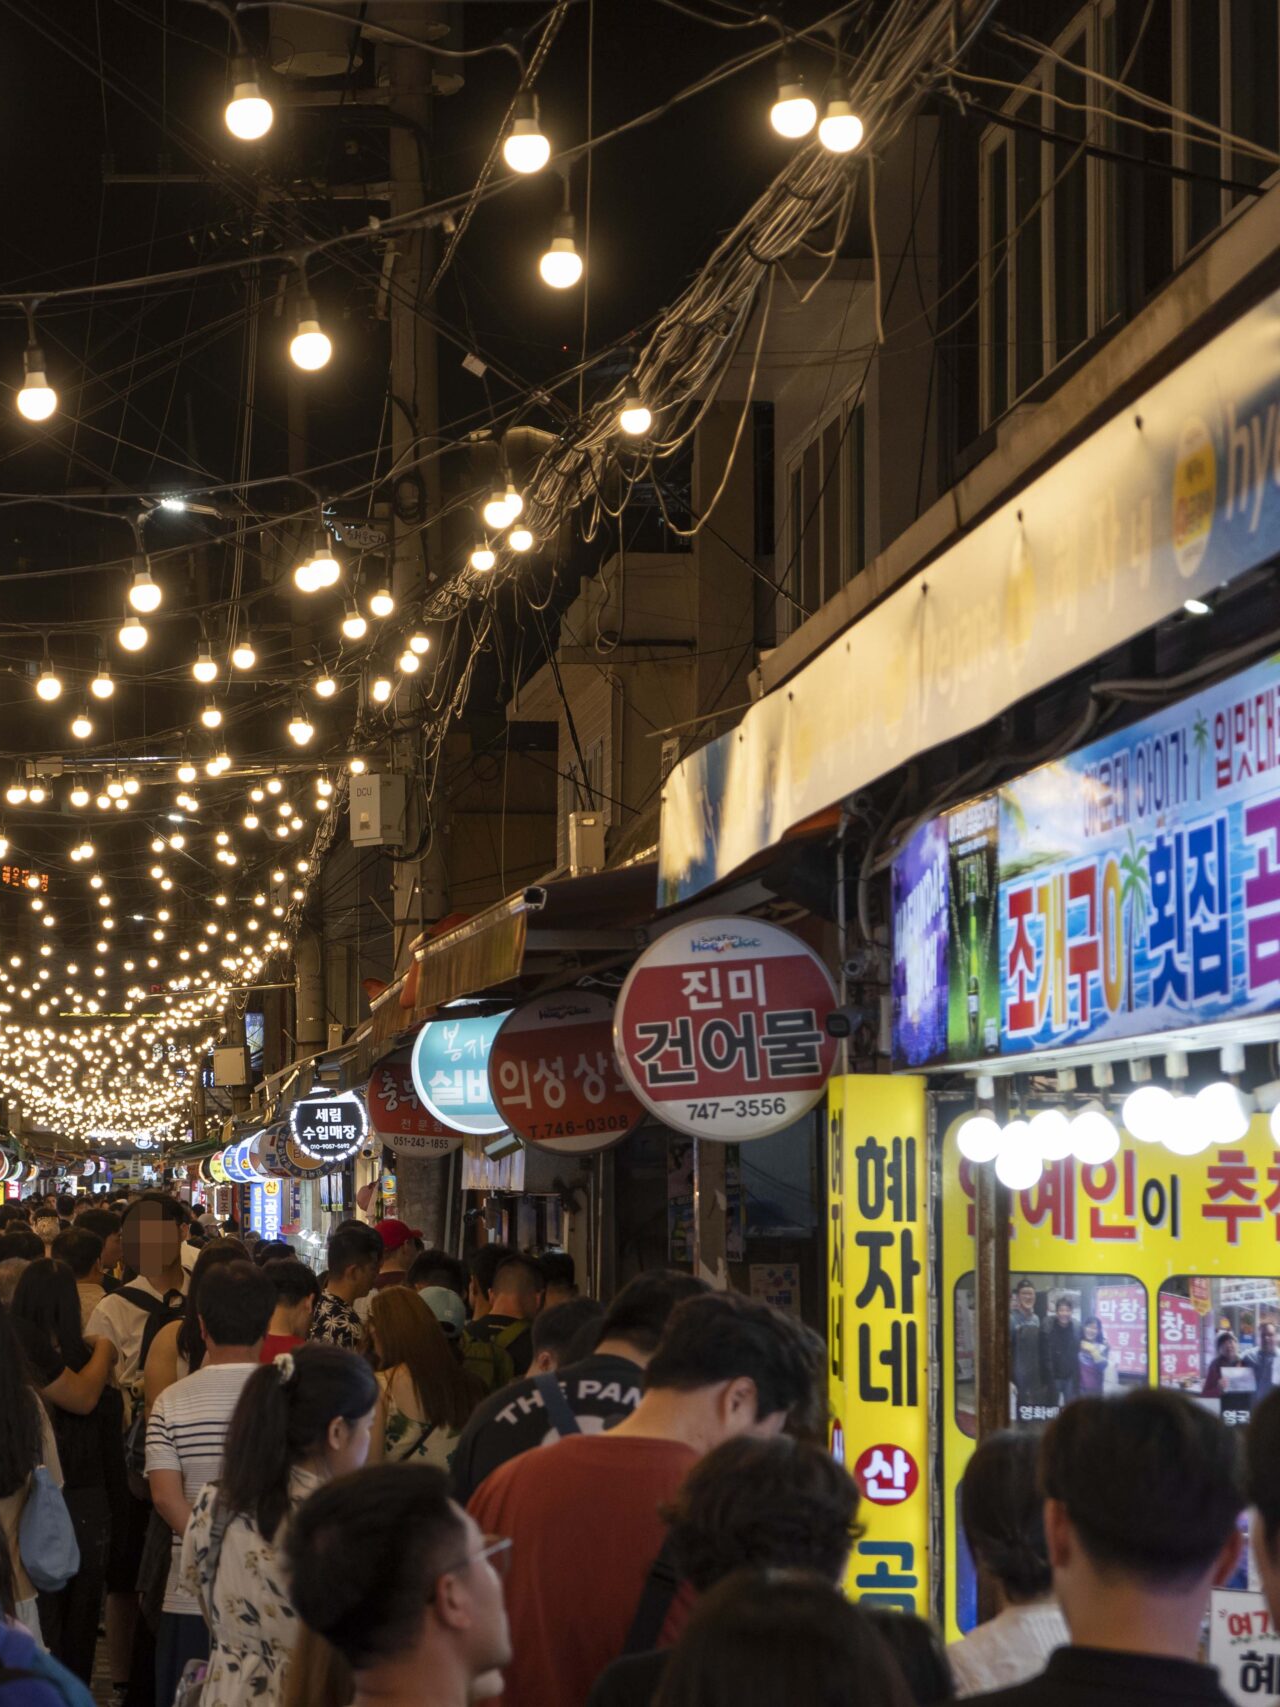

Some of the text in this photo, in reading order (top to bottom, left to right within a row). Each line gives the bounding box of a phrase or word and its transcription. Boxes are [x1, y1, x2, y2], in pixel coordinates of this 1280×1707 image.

[1216, 685, 1280, 789] 입맛대
[1149, 816, 1227, 1007] 횟집
[682, 964, 767, 1011] 진미
[635, 1008, 824, 1087] 건어물
[302, 1125, 357, 1140] 수입매장
[315, 1107, 342, 1123] 세림
[687, 1098, 786, 1120] 747-3556
[393, 1136, 449, 1149] 051-243-1855
[855, 1135, 921, 1408] 혜자네
[862, 1449, 911, 1500] 산
